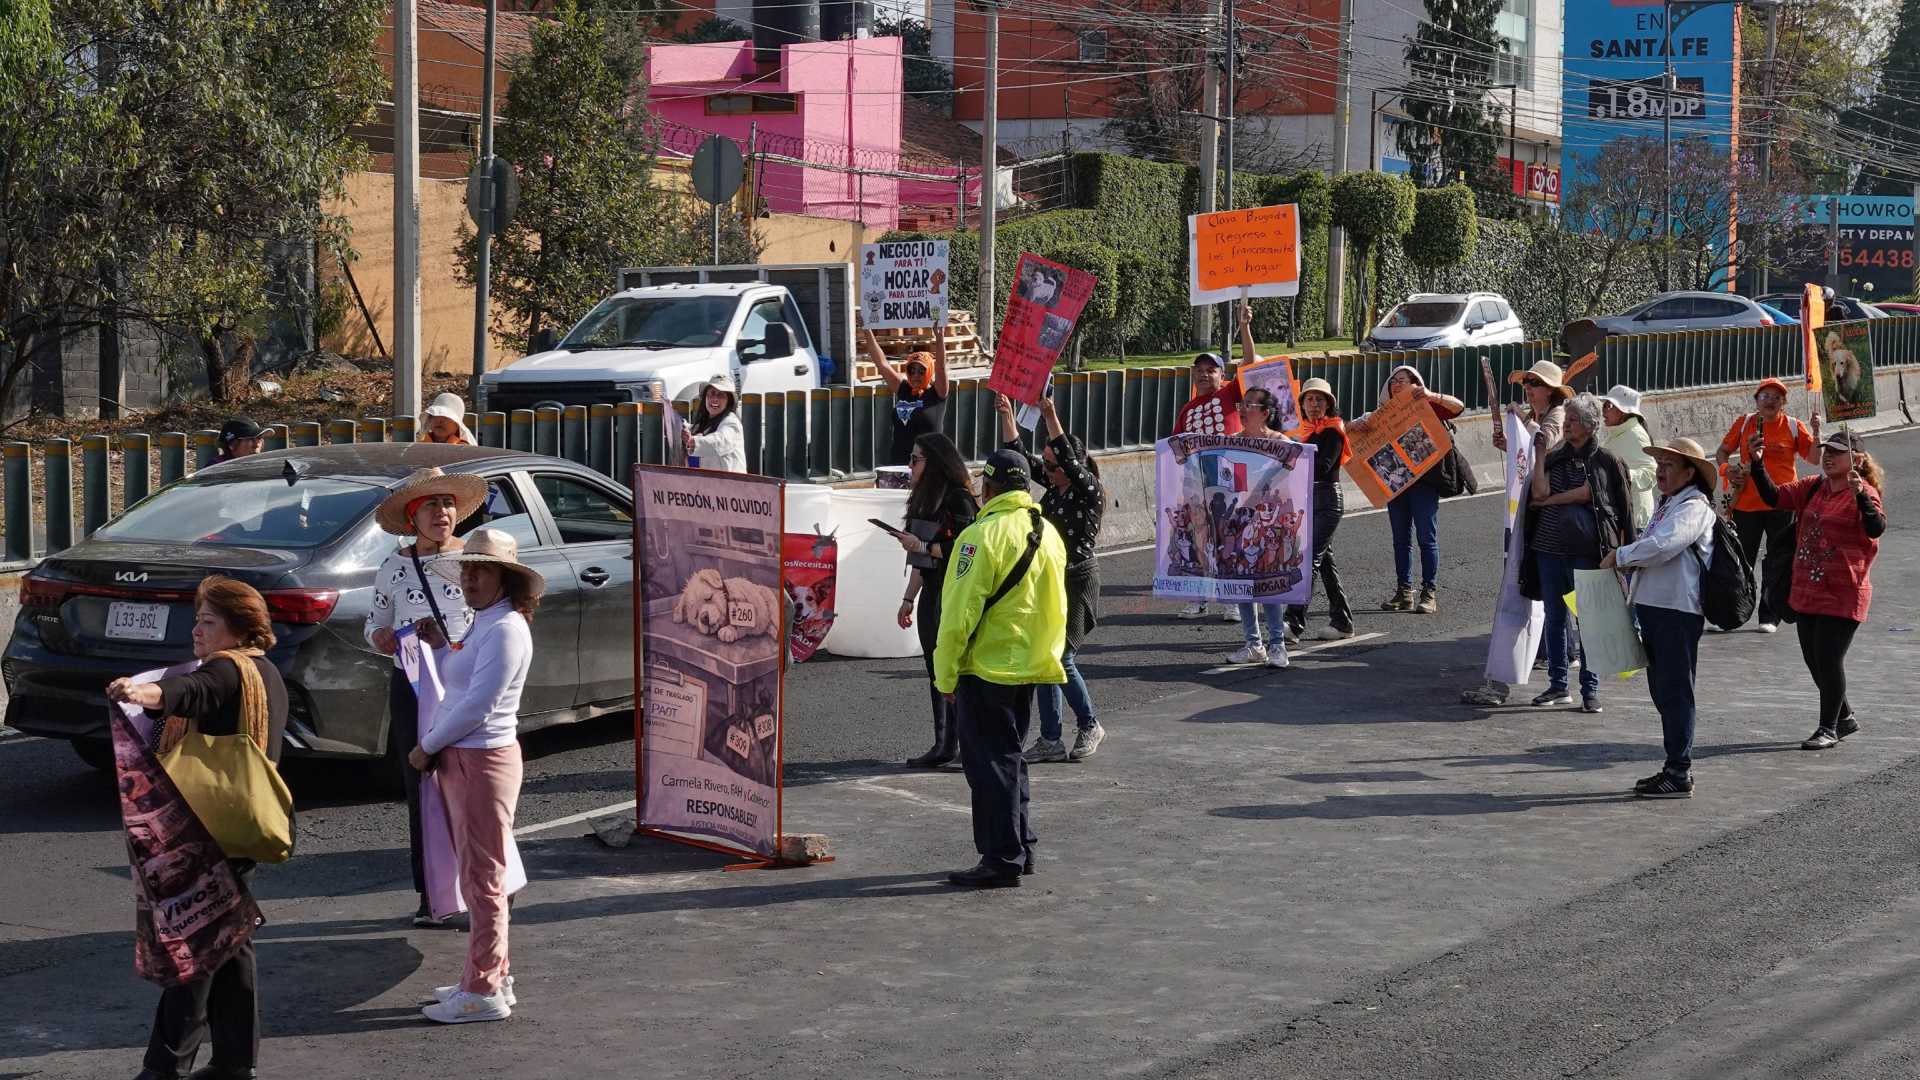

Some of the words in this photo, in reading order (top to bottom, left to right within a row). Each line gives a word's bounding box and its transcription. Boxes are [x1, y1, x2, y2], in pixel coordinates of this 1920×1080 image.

[1637, 13, 1664, 31] EN
[1590, 38, 1677, 58] SANTA
[1682, 37, 1709, 56] FE
[1534, 169, 1557, 193] OXXO
[1825, 202, 1914, 218] SHOWRO
[1858, 229, 1866, 240] Y
[1869, 230, 1903, 240] DEPA
[880, 242, 935, 259] NEGOCIO
[894, 259, 912, 268] PARA
[884, 269, 929, 290] HOGAR
[889, 290, 905, 298] PARA
[883, 300, 933, 321] BRUGADA
[1183, 436, 1221, 453] REFUGIO
[1224, 437, 1285, 458] FRANCISCANO
[653, 489, 665, 504] NI
[667, 490, 715, 512] PERDÓN,
[716, 496, 728, 511] NI
[731, 497, 772, 517] OLVIDO!
[784, 560, 834, 570] osNecesitan
[115, 571, 149, 583] KIA
[1223, 582, 1254, 597] NUESTRO
[1254, 579, 1287, 594] HOGAR
[114, 611, 158, 630] L33-BSL
[731, 606, 753, 622] #260
[654, 687, 664, 696] DE
[666, 690, 694, 703] TRASLADO
[729, 734, 747, 751] #309
[661, 774, 702, 790] Carmela
[704, 779, 730, 796] Rivero,
[730, 783, 743, 799] FAH
[173, 890, 233, 936] queremos
